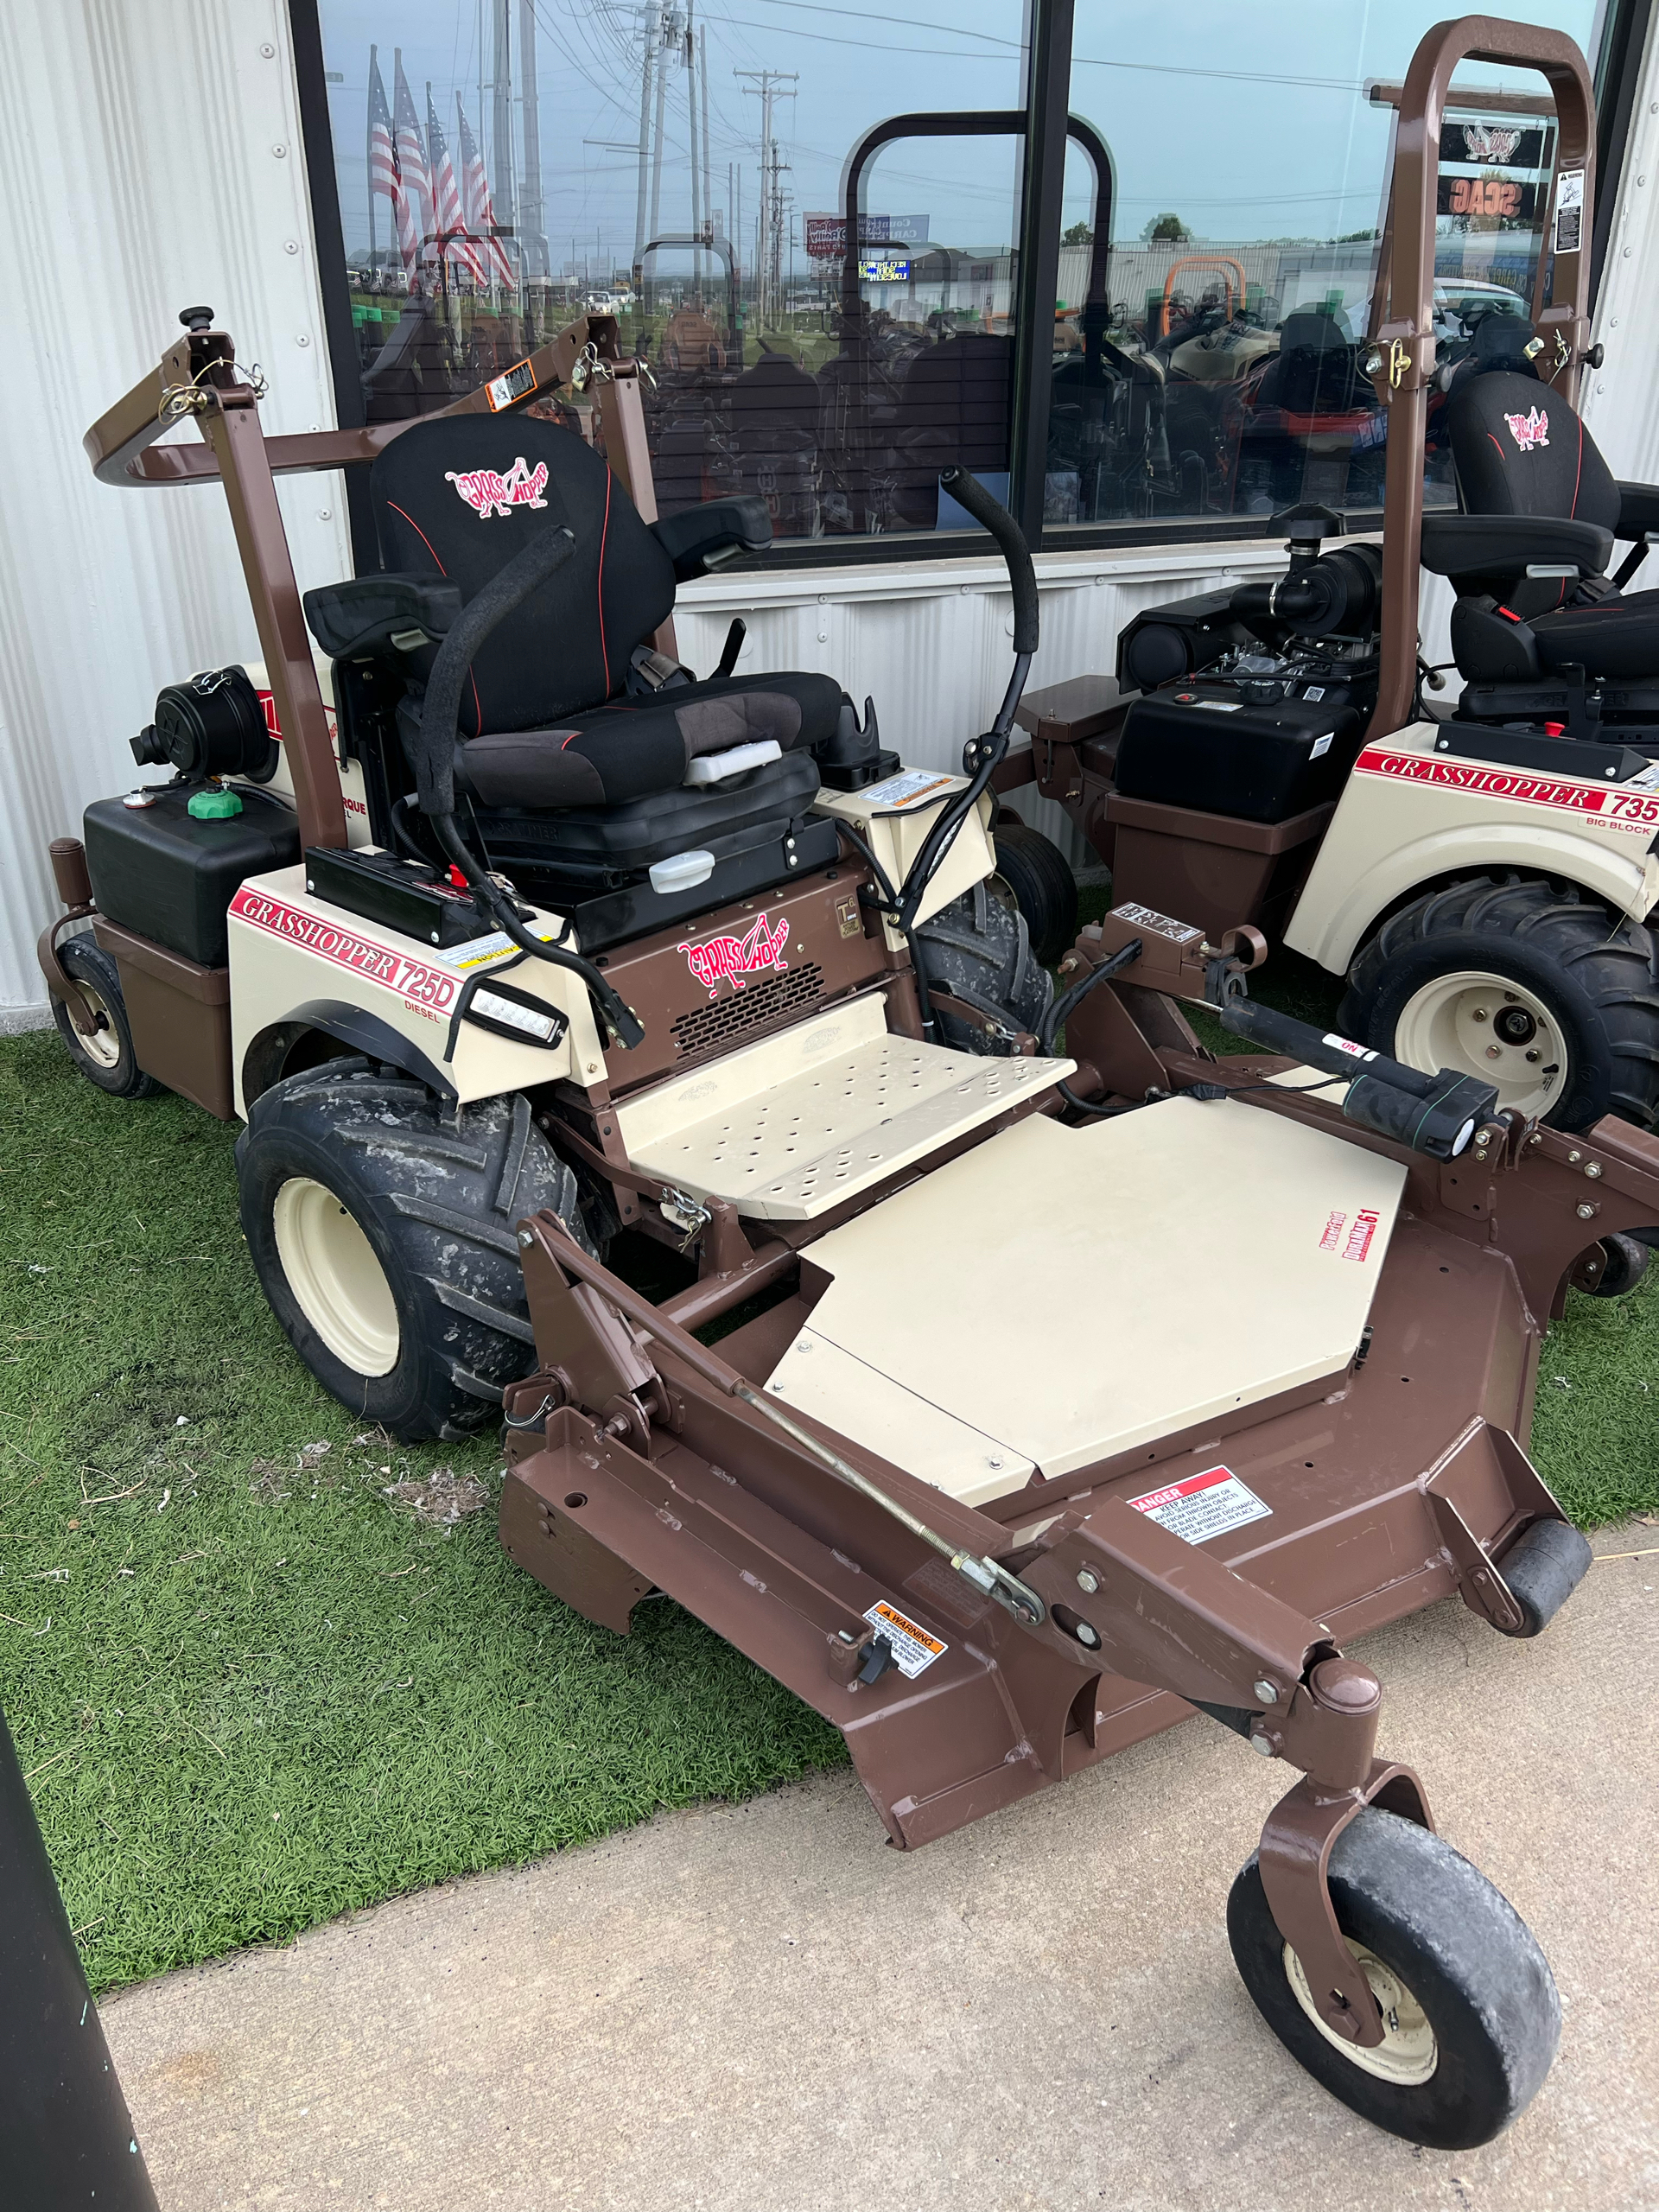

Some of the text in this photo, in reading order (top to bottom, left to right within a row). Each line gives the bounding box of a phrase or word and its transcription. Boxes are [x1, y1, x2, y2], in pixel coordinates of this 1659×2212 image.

[1380, 757, 1590, 808] GRASSHOPPER
[1586, 817, 1651, 836] BIG BLOCK
[242, 896, 395, 979] GRASSHOPPER
[397, 962, 454, 1007] 725D
[404, 999, 441, 1024] DIESEL
[1341, 1042, 1359, 1052] ON
[1357, 1209, 1380, 1223] 61
[1154, 1511, 1175, 1521] AVOID
[1174, 1501, 1200, 1513] SERIOUS
[1200, 1492, 1220, 1503] INJURY
[1160, 1491, 1206, 1512] KEEP AWAY!
[1166, 1492, 1239, 1523] FROM THROWN OBJECTS
[1173, 1523, 1196, 1534] PERATE
[1195, 1512, 1222, 1526] WITHOUT
[1222, 1499, 1257, 1515] DISCHARGE
[1178, 1515, 1198, 1526] BLADE
[1190, 1526, 1205, 1535] SIDE
[1204, 1517, 1228, 1529] SHIELDS
[887, 1622, 904, 1636] OPERATE
[912, 1641, 927, 1652] MOWER
[892, 1614, 933, 1646] WARNING
[890, 1631, 911, 1649] DISCHARGE
[910, 1646, 928, 1660] OPENING
[898, 1651, 915, 1665] BLOWER
